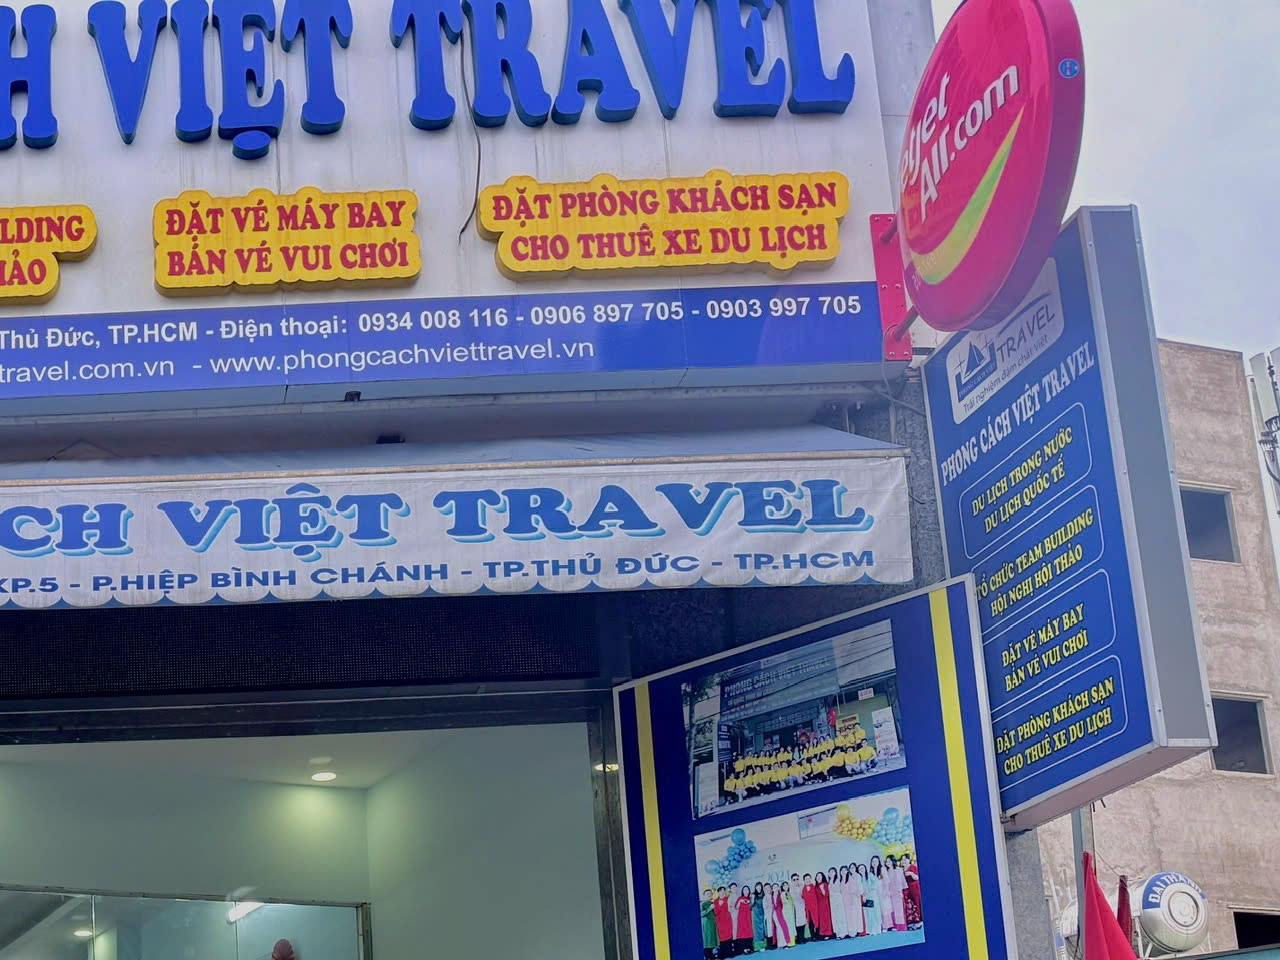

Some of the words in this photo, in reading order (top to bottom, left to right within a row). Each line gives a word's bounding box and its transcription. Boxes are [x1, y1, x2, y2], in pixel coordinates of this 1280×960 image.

[391, 0, 856, 131] TRAVEL
[166, 200, 224, 241] ĐẶT
[231, 199, 269, 232] VÉ
[278, 197, 339, 230] MÁY
[347, 200, 406, 228] BAY
[492, 186, 551, 227] ĐẶT
[560, 185, 659, 218] PHÒNG
[666, 179, 770, 213] KHÁCH
[777, 182, 837, 215] SẠN
[234, 240, 273, 274] VÉ
[279, 244, 333, 271] VUI
[339, 238, 410, 269] CHƠI
[510, 234, 570, 261] CHO
[577, 223, 656, 259] THUÊ
[663, 227, 703, 256] XE
[709, 226, 752, 255] DU
[758, 224, 828, 259] LỊCH
[45, 325, 101, 349] Đức,
[108, 321, 198, 345] TP.HCM
[220, 318, 273, 342] Điện
[358, 312, 413, 333] 0934
[420, 310, 461, 330] 008
[470, 308, 508, 327] 116
[531, 304, 587, 326] 0906
[593, 303, 634, 323] 897
[641, 301, 684, 321] 705
[706, 298, 762, 319] 0903
[769, 297, 810, 316] 997
[818, 295, 861, 315] 705
[209, 337, 595, 374] www.phongcachviettravel.vn
[940, 437, 978, 487] PHONG
[979, 408, 1012, 453] CÁCH
[1012, 382, 1040, 425] VIỆT
[1041, 341, 1095, 403] TRAVEL
[972, 493, 985, 516] DU
[987, 477, 1008, 505] LỊCH
[1009, 450, 1043, 487] TRONG
[1044, 426, 1073, 462] NƯỚC
[157, 482, 411, 563] VIỆT
[432, 478, 875, 544] TRAVEL
[990, 559, 1015, 591] CHỨC
[1015, 543, 1043, 574] TEAM
[1044, 508, 1094, 554] BUILDING
[92, 568, 198, 594] P.HIỆP
[211, 567, 297, 588] BÌNH
[310, 561, 449, 584] CHÁNH
[483, 552, 602, 578] TP.THỦ
[615, 553, 700, 575] ĐỨC
[733, 551, 875, 571] TP.HCM
[1002, 642, 1022, 667] ĐẶT
[1024, 632, 1038, 653] VÉ
[1038, 618, 1061, 647] MÁY
[1062, 603, 1085, 632] BAY
[996, 727, 1017, 753] ĐẶT
[1017, 713, 1052, 745] PHÒNG
[1053, 694, 1090, 724] KHÁCH
[1091, 676, 1115, 705] SẠN
